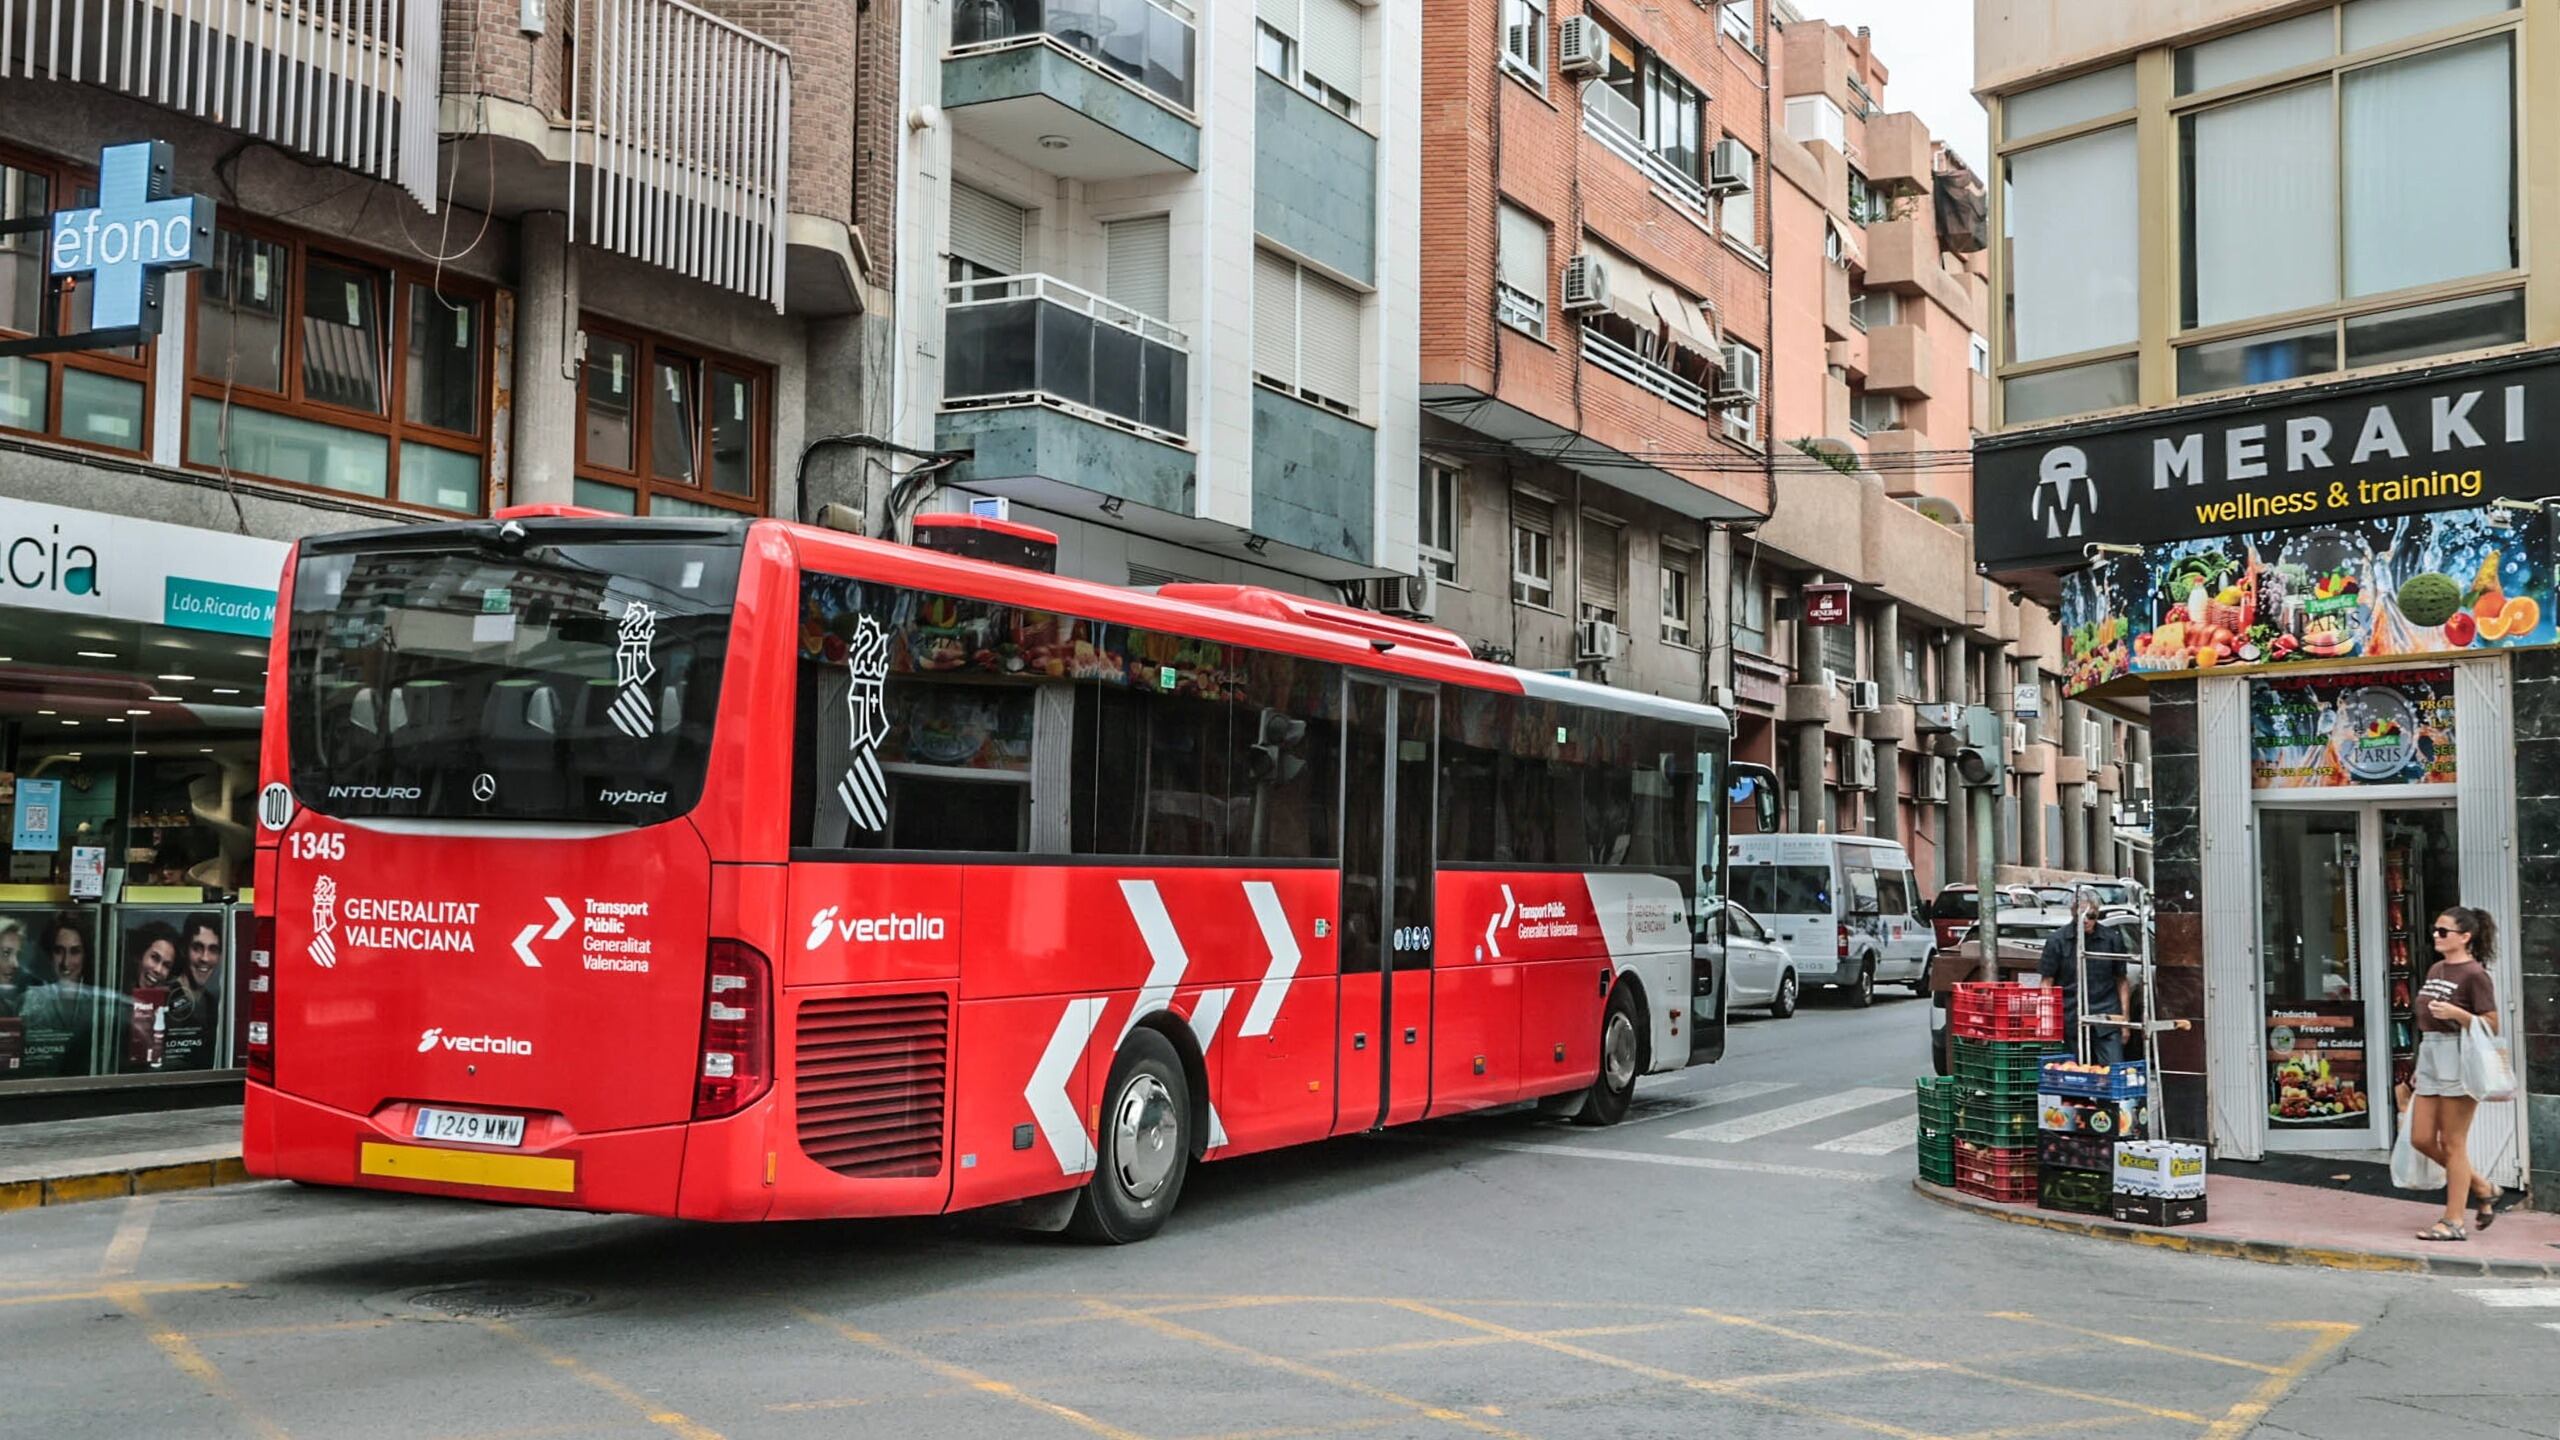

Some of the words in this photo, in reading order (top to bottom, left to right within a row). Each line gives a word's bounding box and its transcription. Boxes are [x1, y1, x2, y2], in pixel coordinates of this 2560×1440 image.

[2152, 384, 2527, 490] MERAKI
[2195, 489, 2317, 525] wellness
[2326, 481, 2350, 508] &
[2357, 467, 2482, 505] training
[0, 524, 101, 597] cia
[172, 592, 261, 621] Ldo.Ricardo
[2297, 610, 2362, 634] PARIS
[2354, 746, 2402, 764] PARIS
[328, 785, 421, 801] INTOURO
[599, 788, 668, 806] hybrid
[264, 787, 287, 827] 100
[288, 832, 345, 860] 1345
[344, 898, 480, 925] GENERALITAT
[584, 898, 649, 919] Transport
[1518, 902, 1547, 921] Transport
[1548, 900, 1566, 917] Públic
[584, 916, 626, 935] Públic
[838, 912, 945, 942] vectalia
[1518, 922, 1549, 939] Generalitat
[1549, 921, 1578, 938] Valenciana
[345, 926, 475, 953] VALENCIANA
[583, 936, 652, 955] Generalitat
[583, 955, 649, 973] Valenciana
[2271, 1009, 2318, 1019] Productos
[2300, 1025, 2336, 1033] Frescos
[441, 1034, 533, 1056] vectalia
[2317, 1040, 2328, 1048] de
[2330, 1039, 2364, 1048] Calidad
[434, 1114, 479, 1138] 1249
